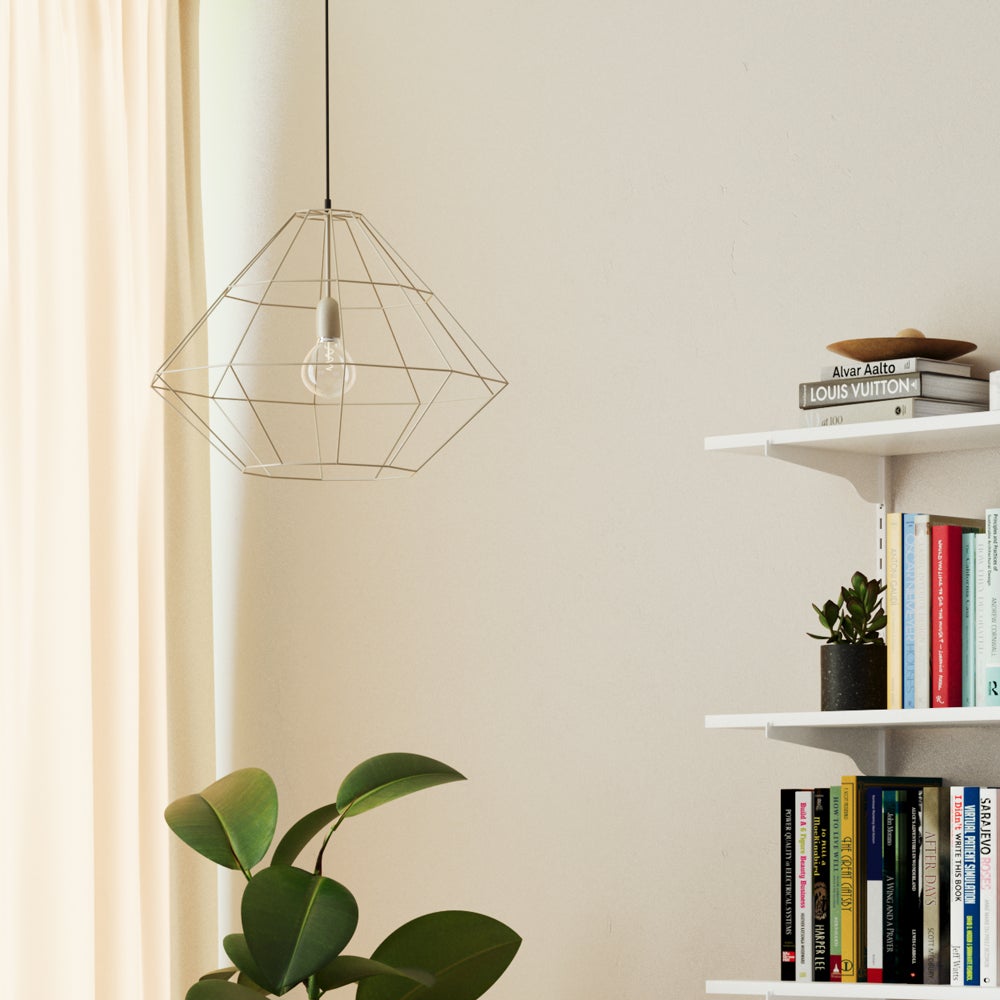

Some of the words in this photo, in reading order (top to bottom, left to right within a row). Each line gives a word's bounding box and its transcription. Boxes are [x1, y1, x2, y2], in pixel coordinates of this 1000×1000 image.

[832, 365, 861, 378] Alvar
[863, 362, 896, 376] Aalto
[810, 384, 848, 402] LOUIS
[850, 378, 910, 398] VUITTON
[905, 534, 914, 576] OSCAR
[905, 583, 914, 641] NIEMEYER
[905, 644, 914, 694] HOUSES
[833, 819, 840, 830] TO
[965, 804, 976, 834] VIRTUAL
[980, 798, 991, 855] SARAJEVO
[841, 836, 852, 852] THE
[925, 832, 936, 872] AFTER
[965, 835, 976, 863] PATIENT
[841, 855, 852, 880] GREAT
[980, 857, 991, 890] ROSES
[841, 882, 852, 912] GATSBY
[925, 876, 936, 906] DAYS
[965, 864, 976, 904] SIMULATION
[814, 924, 825, 954] HARPER
[952, 945, 961, 960] Jeff
[814, 956, 825, 970] LEE
[952, 961, 961, 981] Watts
